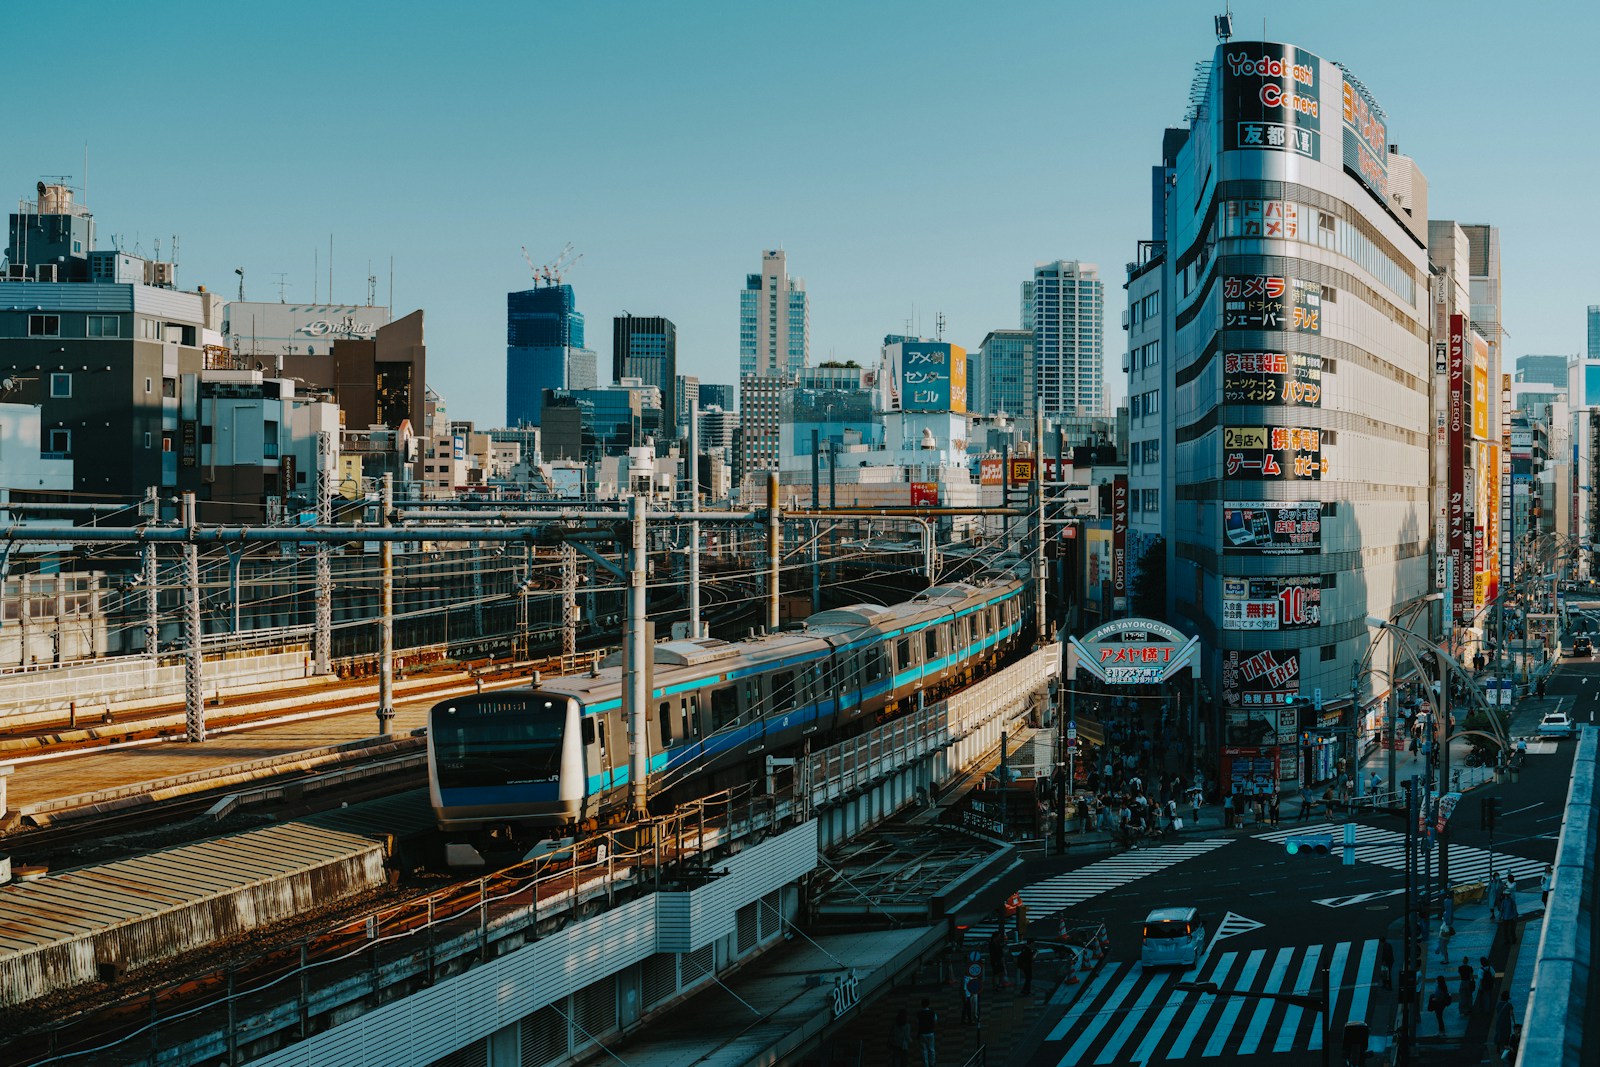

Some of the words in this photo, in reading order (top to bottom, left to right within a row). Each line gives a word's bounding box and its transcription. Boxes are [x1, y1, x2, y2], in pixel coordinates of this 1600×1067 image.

[1227, 52, 1313, 87] Yodobashi
[1259, 83, 1318, 118] Camera
[1244, 124, 1310, 152] 友都八喜
[1227, 202, 1297, 219] ヨドバシ
[1245, 220, 1297, 237] カメラ
[1224, 277, 1286, 299] カメラ
[1249, 301, 1290, 312] ドライヤー
[1226, 312, 1287, 326] シェーバー
[1293, 306, 1319, 330] テレビ
[908, 351, 945, 365] アメ横
[1225, 353, 1288, 374] 家電製品
[1452, 334, 1462, 380] カラオケ
[904, 371, 949, 384] センター
[1225, 378, 1276, 389] スーツケース
[914, 390, 939, 403] ビル
[1225, 391, 1245, 400] マウス
[1247, 390, 1276, 401] インク
[1281, 380, 1320, 403] パソコン
[1226, 429, 1264, 447] 2号店へ
[1271, 427, 1319, 451] 携帯電話
[1016, 464, 1030, 478] 薬
[1227, 453, 1281, 476] ゲーム
[1294, 456, 1320, 476] ホビー
[1115, 487, 1126, 533] カラオケ
[1451, 492, 1461, 538] カラオケ
[1437, 559, 1445, 584] ルノアール
[1475, 575, 1483, 604] 処方せん
[1224, 602, 1242, 611] 入会金
[1246, 603, 1276, 618] 無料
[1099, 647, 1176, 663] アメヤ横丁
[1240, 650, 1279, 682] TAX
[1266, 656, 1299, 688] FREE
[1244, 692, 1298, 704] 免税品取
[834, 968, 859, 1015] atré
